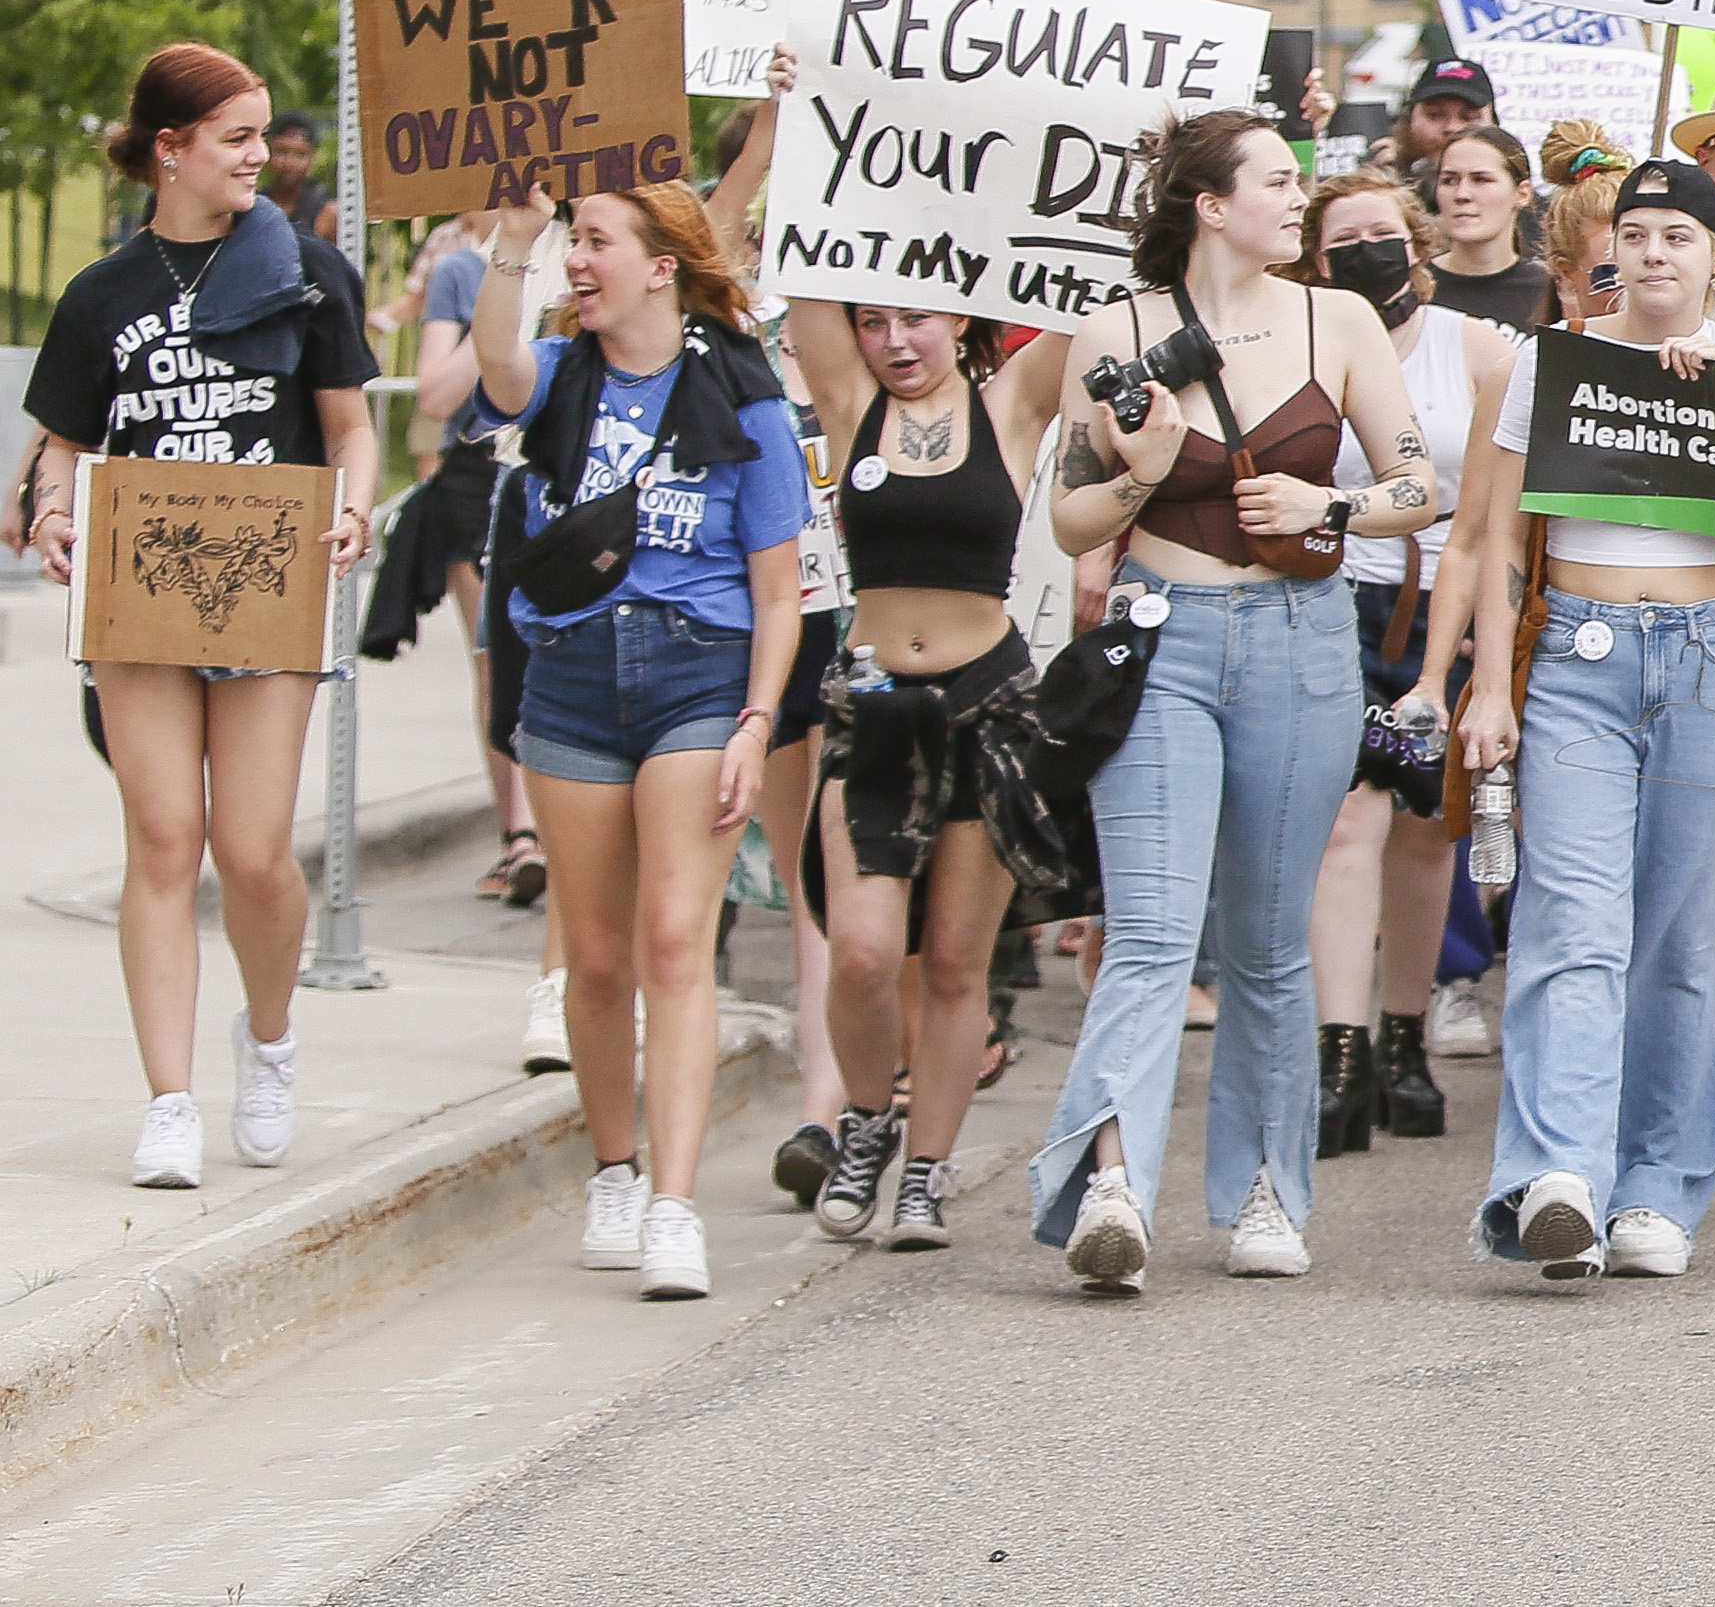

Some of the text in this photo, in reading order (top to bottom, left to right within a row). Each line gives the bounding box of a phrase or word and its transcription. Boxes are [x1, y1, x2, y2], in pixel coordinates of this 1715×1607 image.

[467, 24, 600, 106] NOT
[385, 95, 599, 177] OVARY-
[486, 132, 683, 212] ACTING
[810, 94, 1148, 231] Your DI
[147, 348, 235, 384] OUR
[115, 375, 278, 431] FUTURES
[1570, 383, 1715, 430] Abortion
[154, 430, 235, 464] OUR
[1569, 417, 1680, 458] Health
[137, 491, 305, 511] My Body My Choice
[645, 490, 705, 515] OWN
[1304, 537, 1338, 554] GOLF
